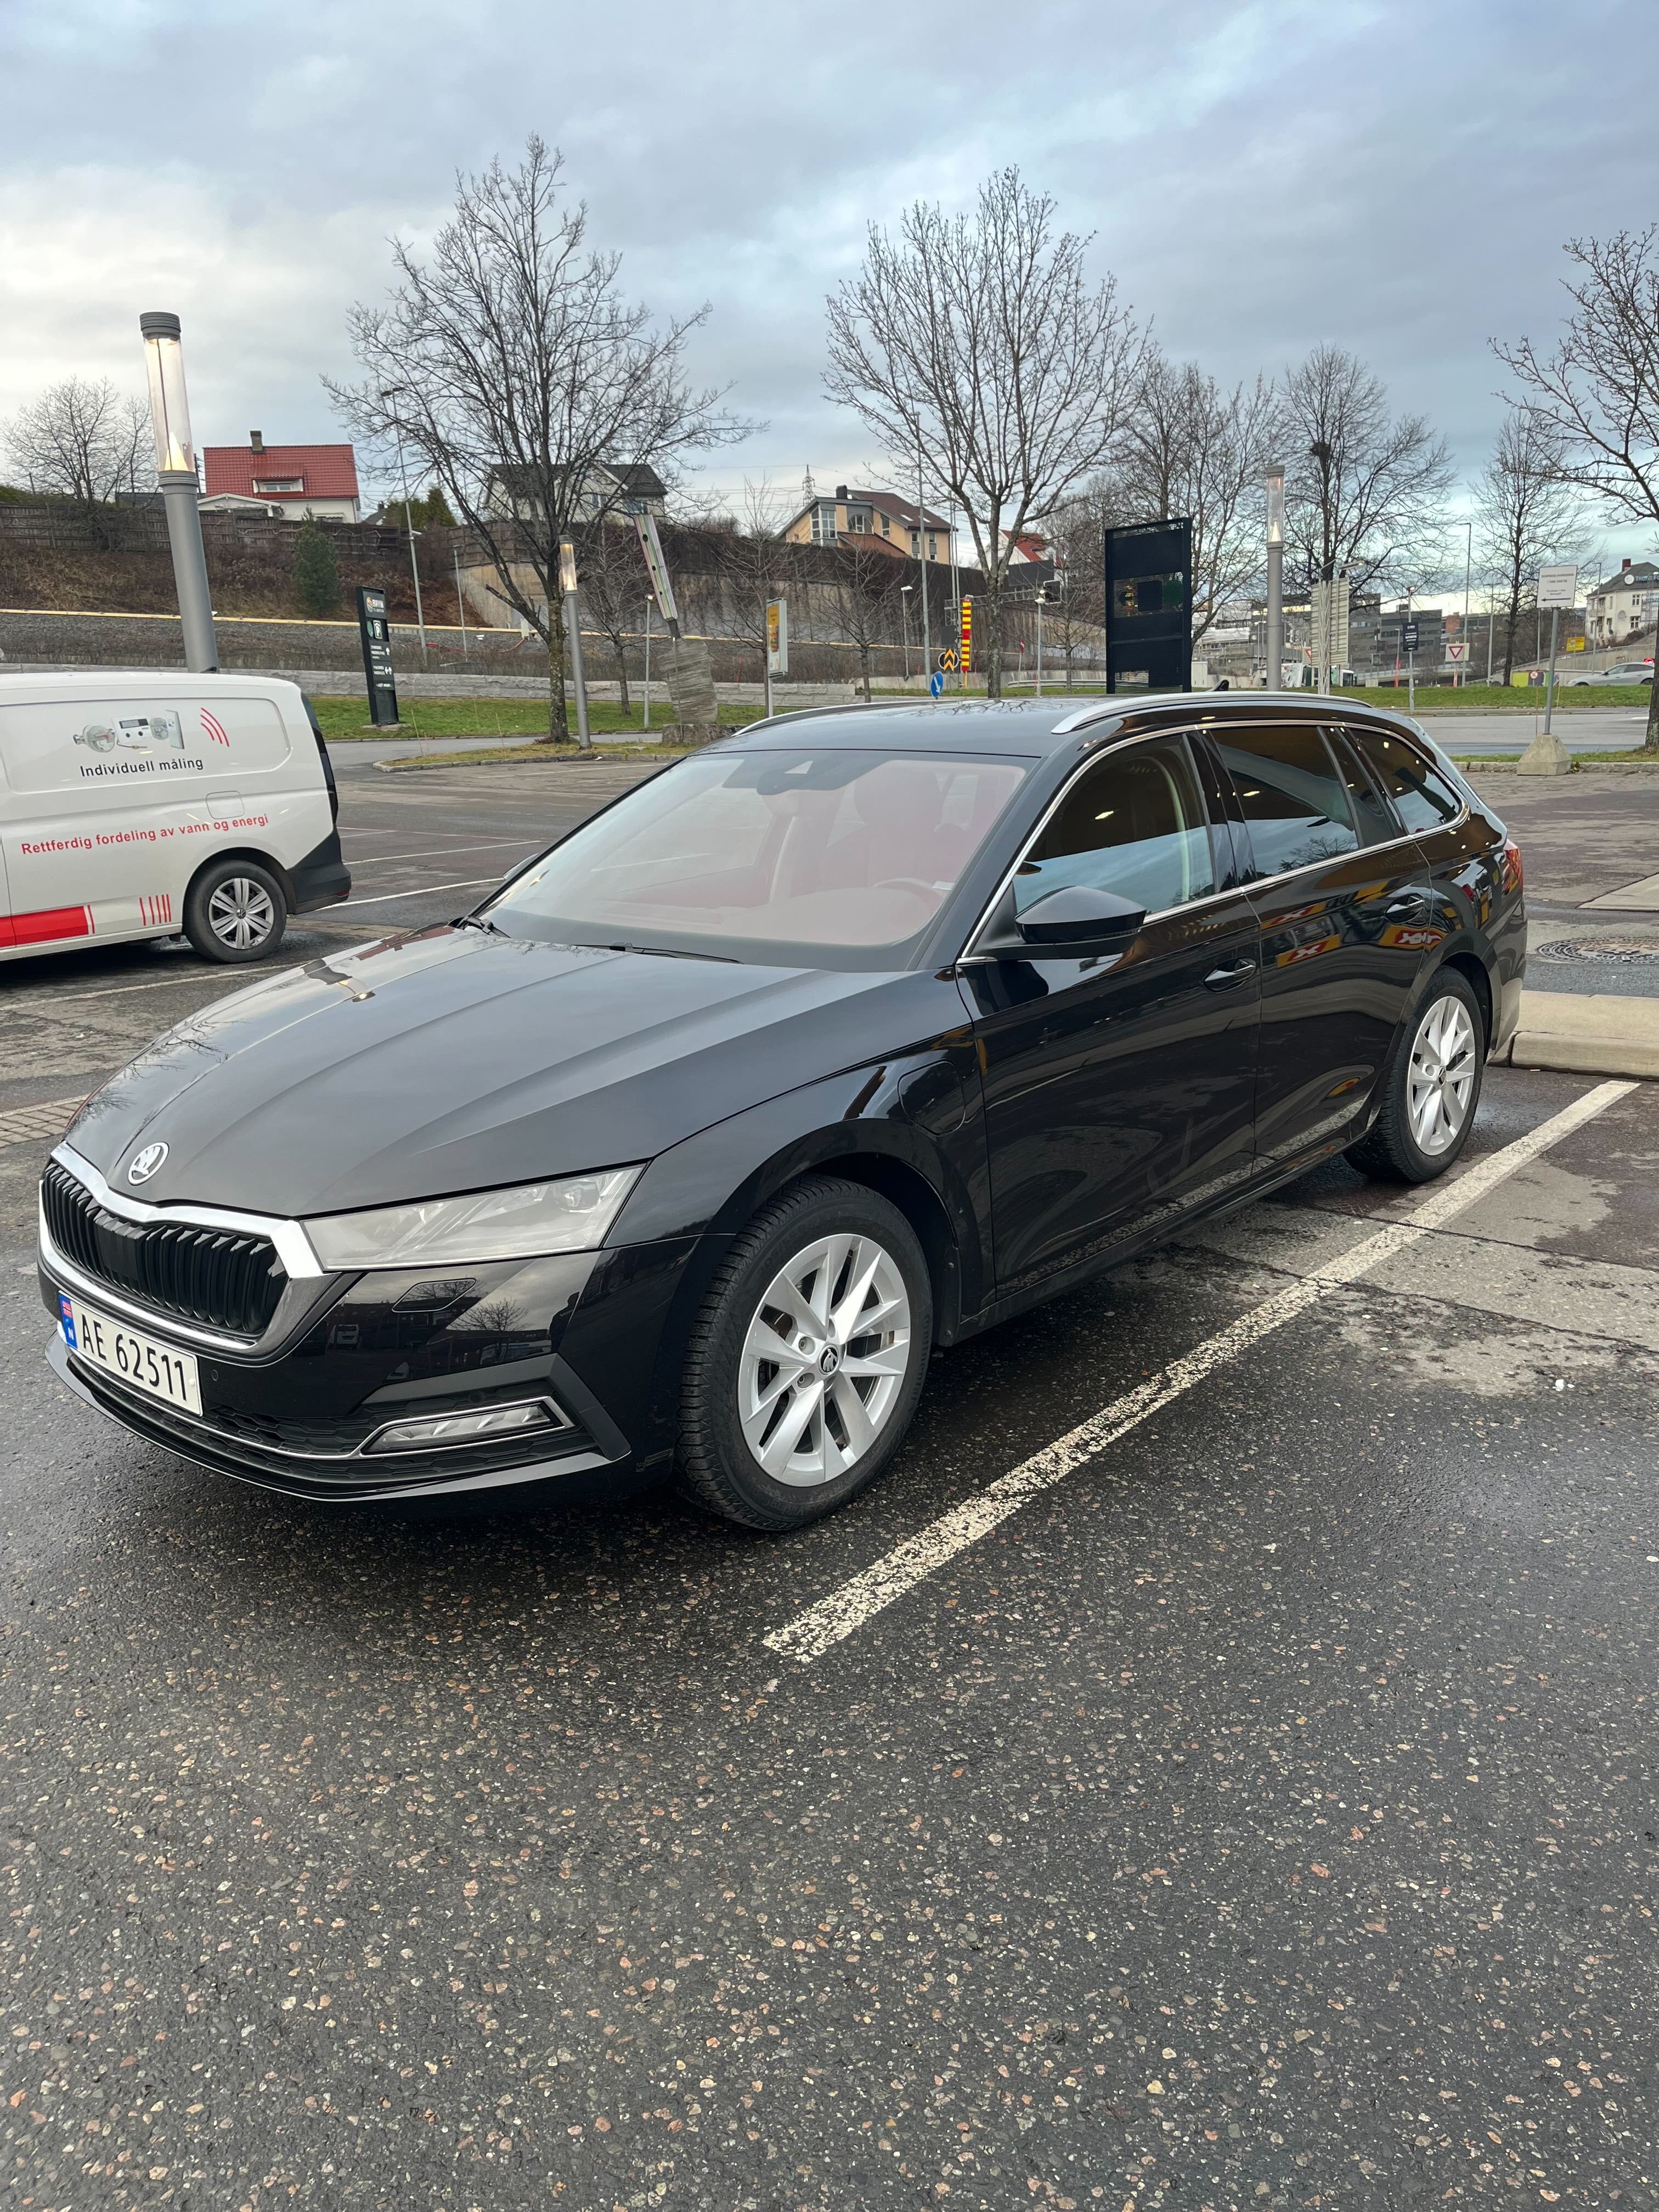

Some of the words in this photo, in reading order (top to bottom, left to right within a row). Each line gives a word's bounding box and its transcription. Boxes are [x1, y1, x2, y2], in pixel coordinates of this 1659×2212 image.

[80, 761, 154, 777] Individuell
[160, 758, 204, 770] måling
[21, 837, 92, 854] Rettferdig
[96, 830, 156, 845] fordeling
[160, 827, 174, 837] av
[178, 822, 210, 834] vann
[213, 820, 229, 831] og
[232, 814, 269, 827] energi
[68, 1327, 74, 1340] N
[82, 1313, 107, 1361] AE
[116, 1333, 187, 1401] 62511
